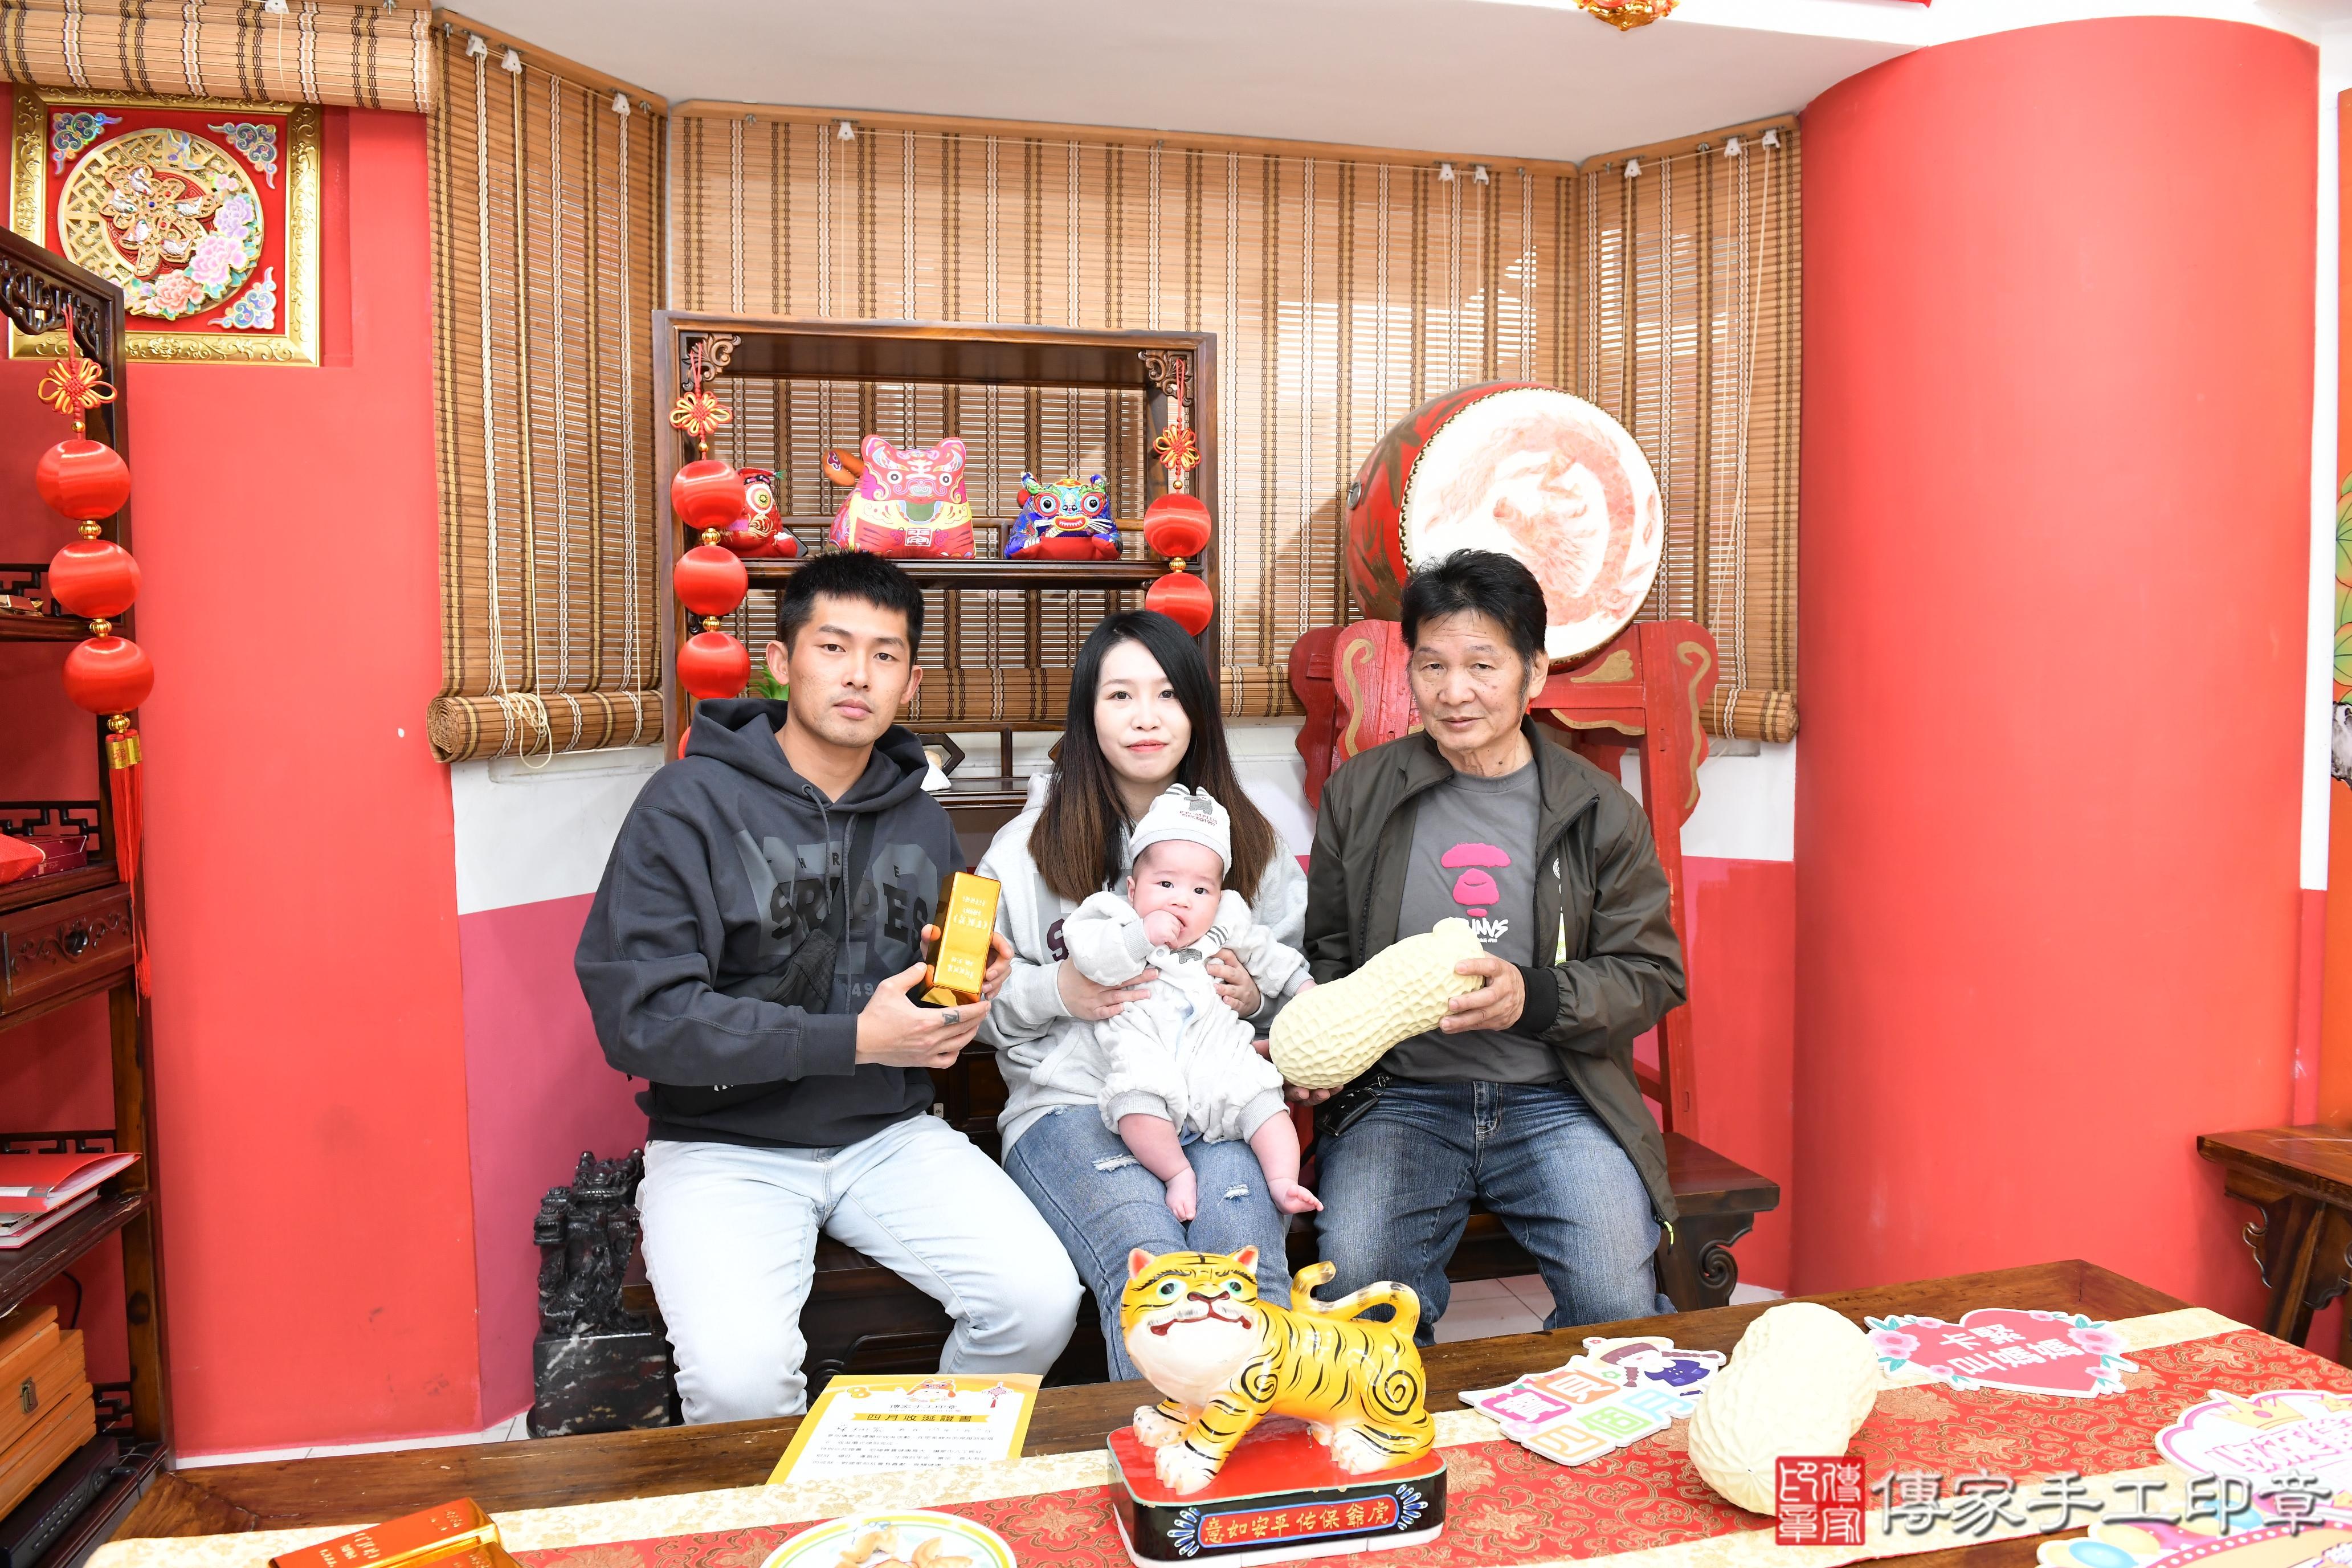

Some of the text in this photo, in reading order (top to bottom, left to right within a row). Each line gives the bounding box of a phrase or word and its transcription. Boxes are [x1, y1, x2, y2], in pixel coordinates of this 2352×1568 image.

[1939, 1324, 2026, 1350] 卡緊
[1946, 1338, 2085, 1375] 叫媽媽
[1529, 1389, 1694, 1457] 四個月
